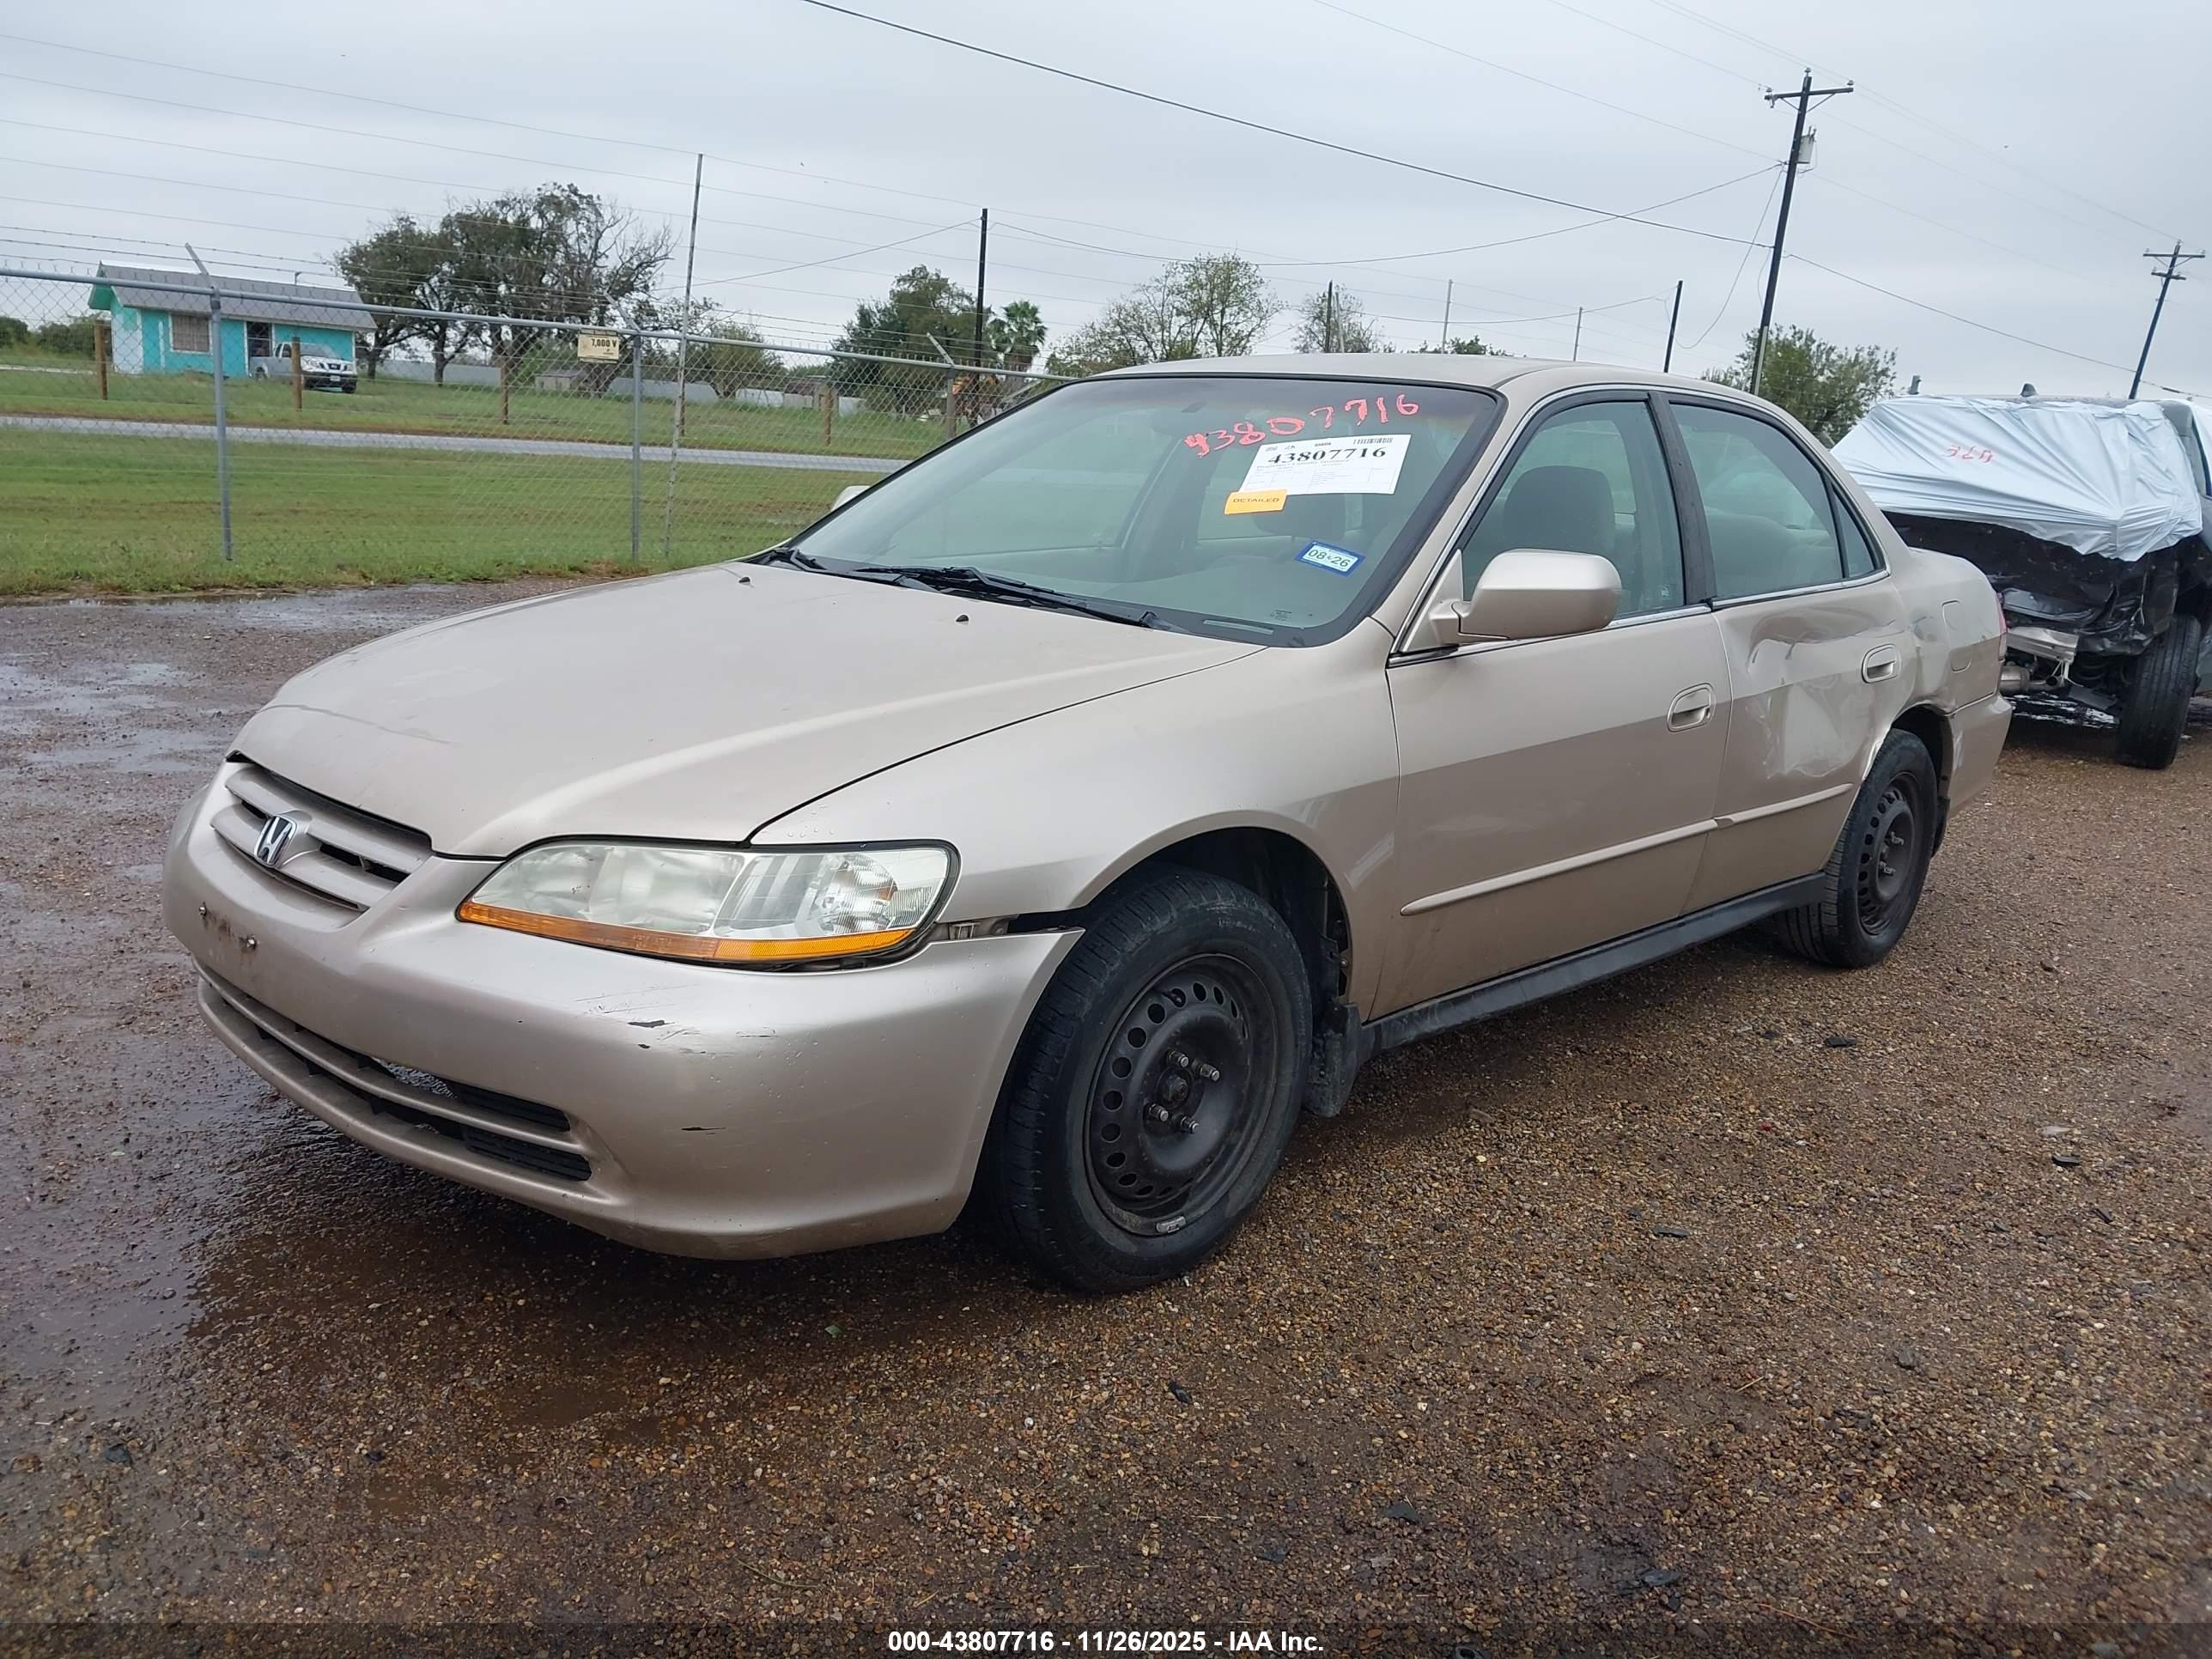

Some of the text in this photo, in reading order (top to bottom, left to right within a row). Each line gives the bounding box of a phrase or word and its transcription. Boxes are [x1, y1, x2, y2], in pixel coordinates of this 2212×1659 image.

[591, 338, 617, 348] 7,000 V
[1267, 447, 1387, 464] 43807716
